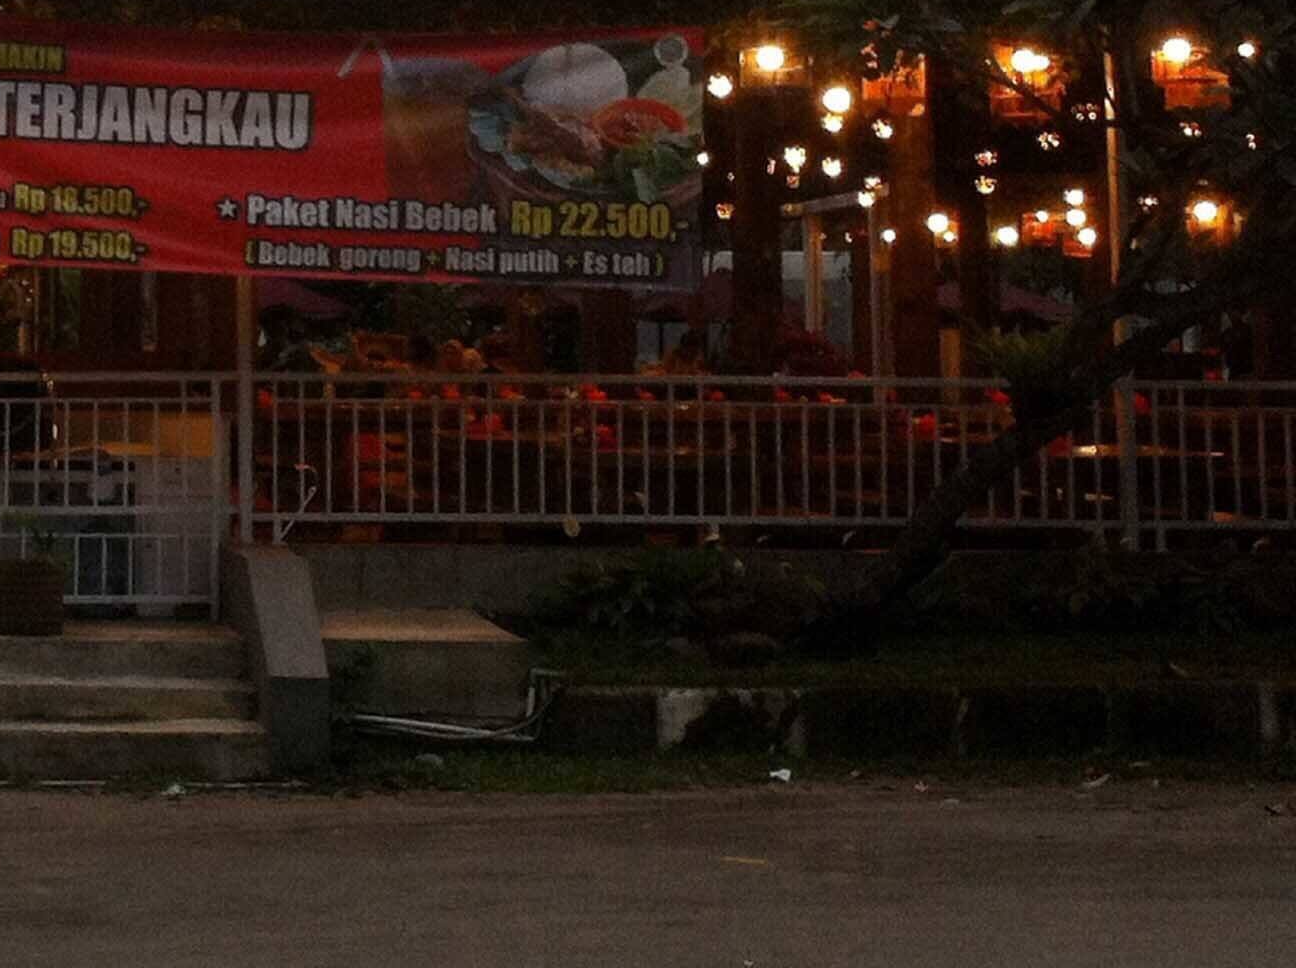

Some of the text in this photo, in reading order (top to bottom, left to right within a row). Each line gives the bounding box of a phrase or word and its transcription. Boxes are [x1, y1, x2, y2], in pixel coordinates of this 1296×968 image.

[14, 183, 46, 213] Rp
[247, 194, 329, 228] Paket
[335, 197, 399, 229] Nasi
[405, 200, 497, 233] Bebek
[510, 200, 553, 239] Rp
[11, 229, 44, 259] Rp
[339, 246, 422, 273] goreng
[445, 246, 496, 272] Nasi
[499, 249, 560, 275] putih
[582, 250, 609, 275] Es
